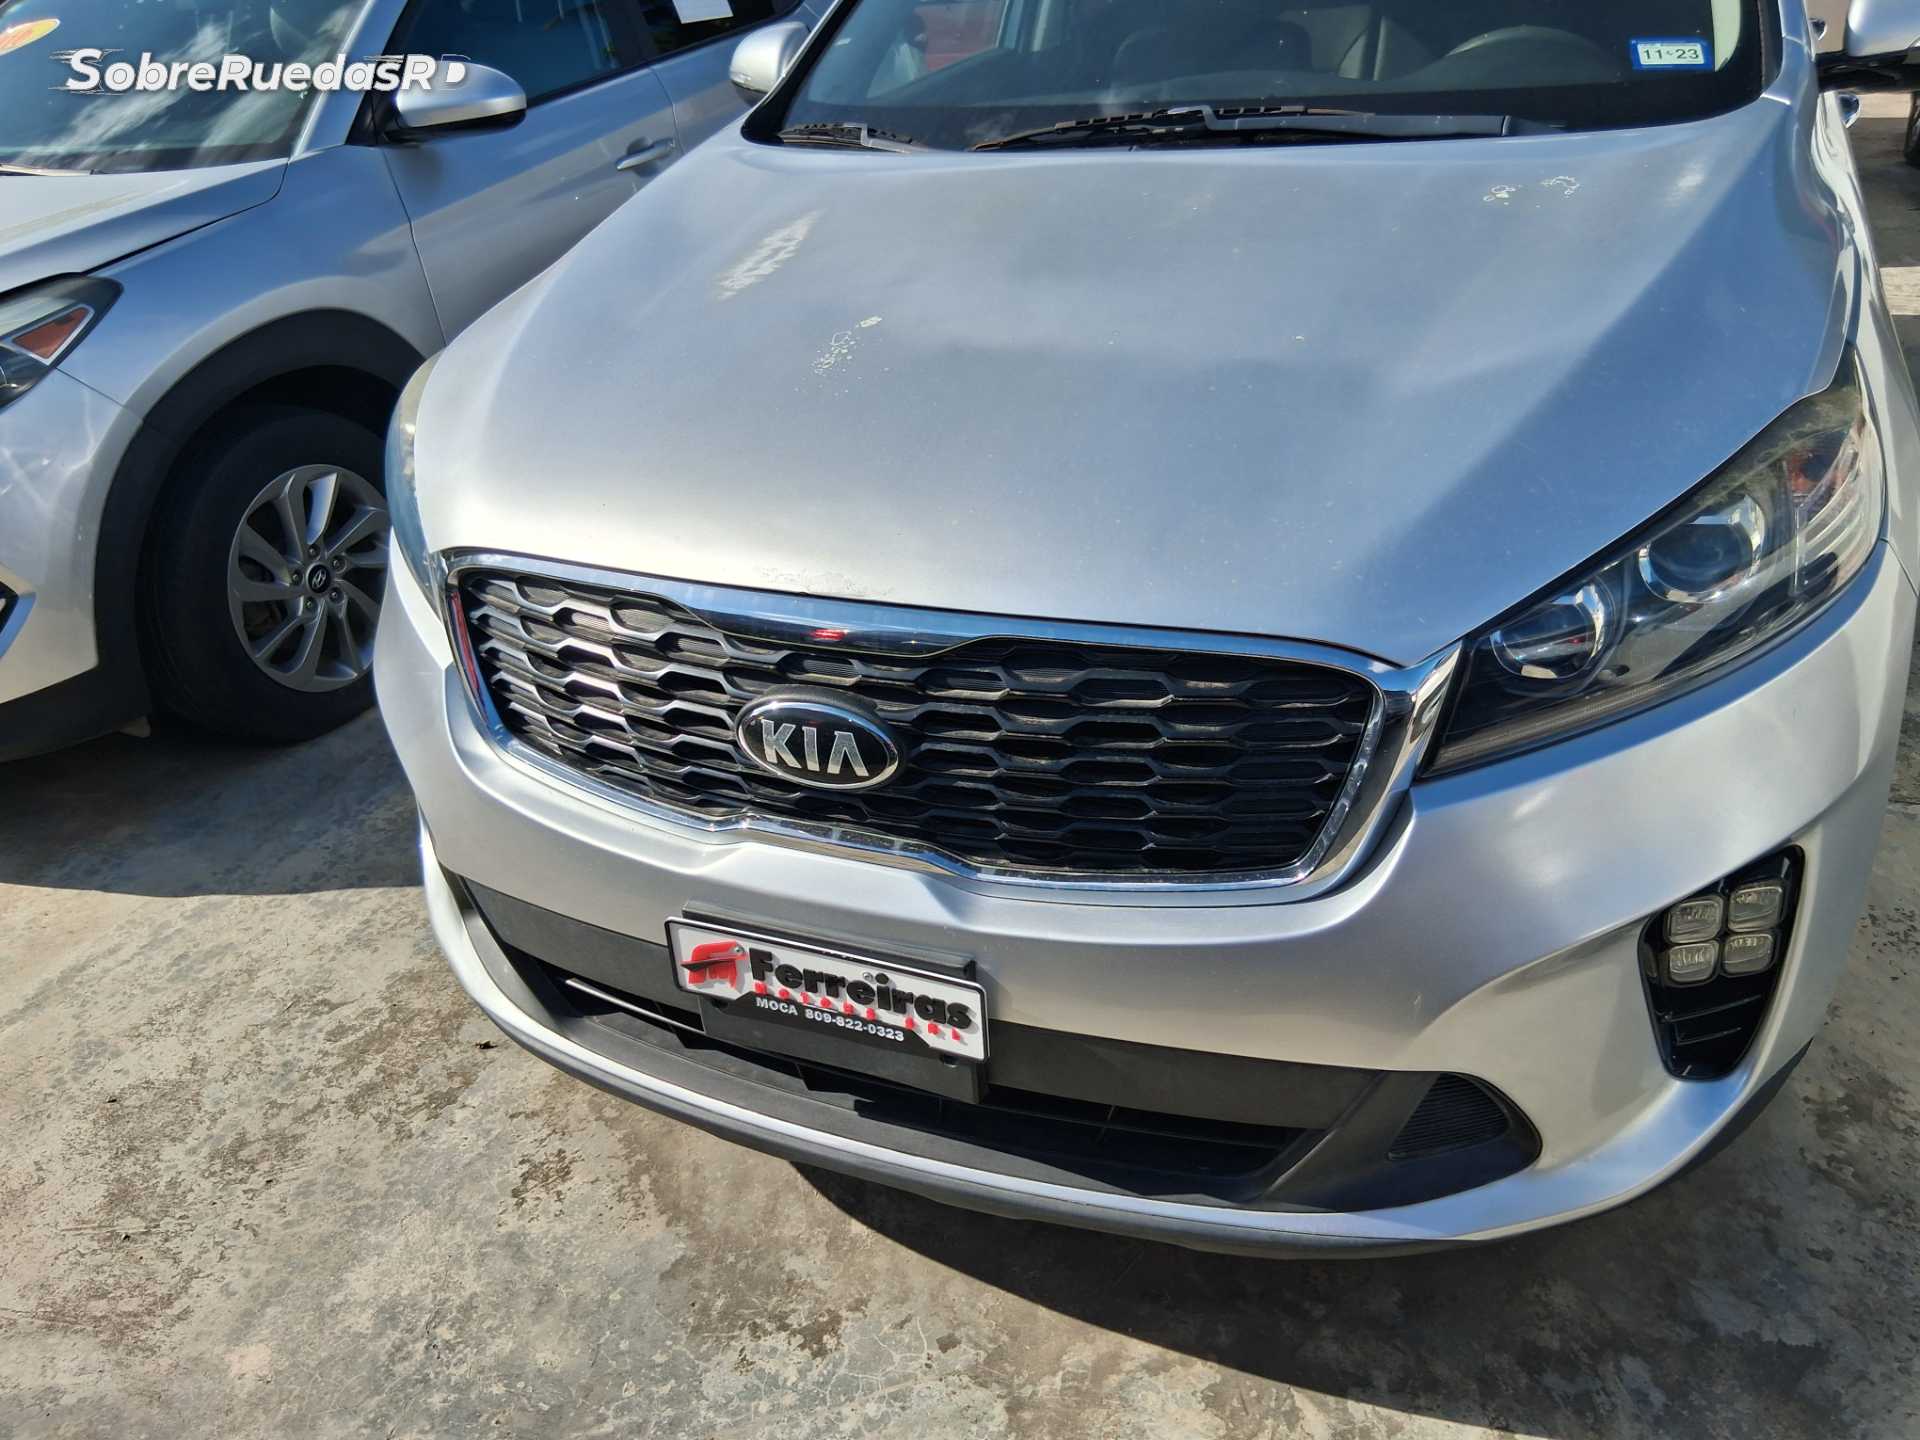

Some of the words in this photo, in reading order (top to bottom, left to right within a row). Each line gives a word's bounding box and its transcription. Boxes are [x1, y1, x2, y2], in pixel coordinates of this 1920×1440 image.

[761, 718, 869, 777] KIA
[749, 948, 972, 1029] Ferreiras
[755, 996, 798, 1017] MOCA
[804, 1008, 904, 1042] 809-822-0323
